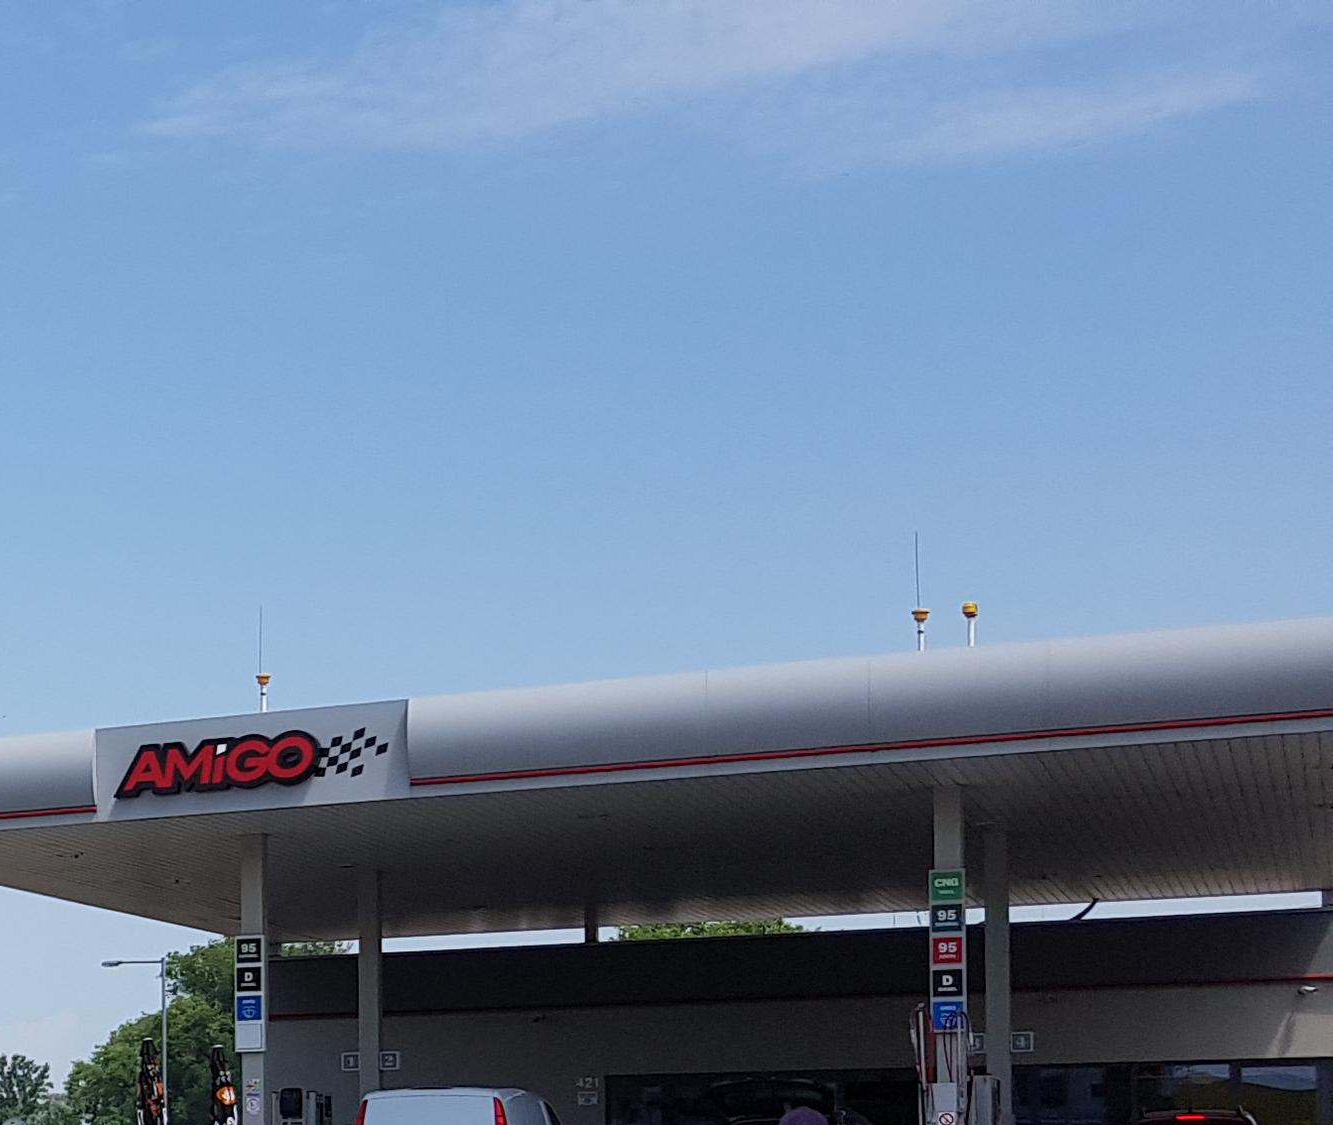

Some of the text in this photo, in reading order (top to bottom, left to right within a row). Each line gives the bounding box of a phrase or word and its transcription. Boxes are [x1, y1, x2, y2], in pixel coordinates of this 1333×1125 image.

[934, 877, 959, 887] CNG
[937, 909, 957, 921] 95
[240, 943, 257, 953] 95
[938, 942, 958, 953] 95
[244, 971, 254, 982] D
[942, 974, 953, 986] D
[383, 1056, 395, 1067] 2
